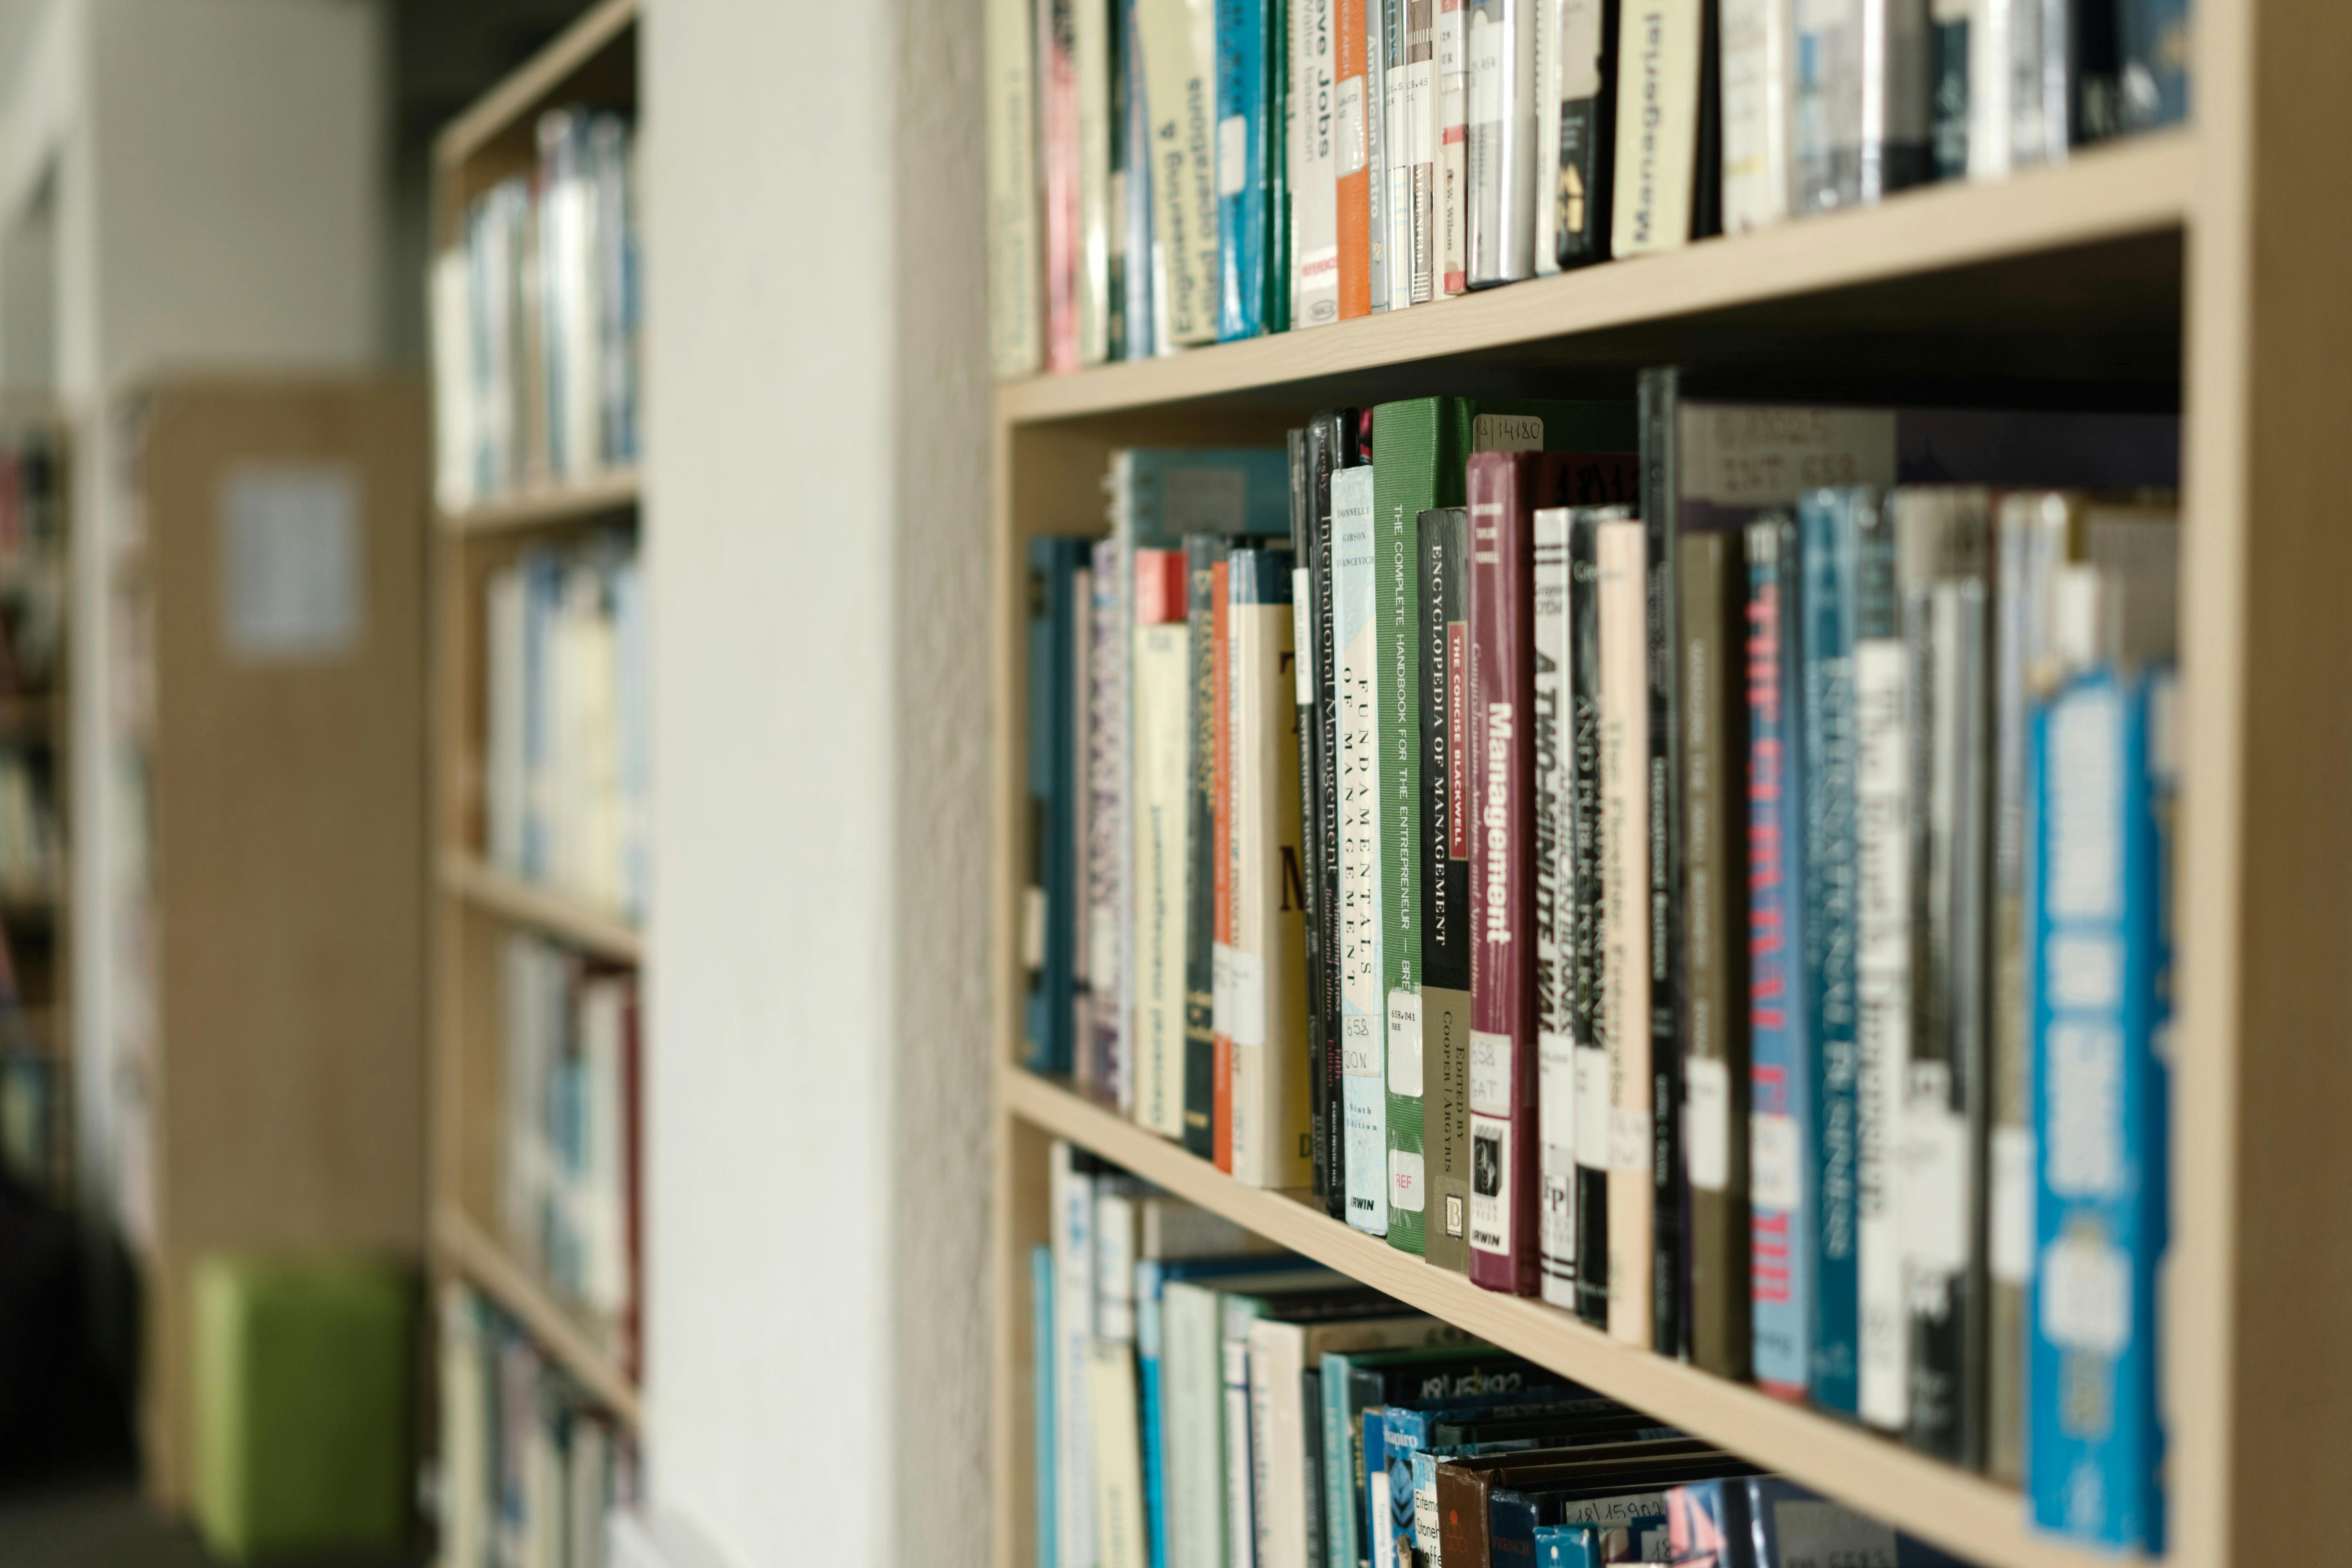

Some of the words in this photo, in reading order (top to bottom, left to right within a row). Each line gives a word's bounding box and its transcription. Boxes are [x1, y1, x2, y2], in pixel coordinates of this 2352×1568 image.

[1367, 35, 1378, 146] American
[1304, 67, 1315, 162] Isaacson
[1318, 69, 1330, 158] Jobs
[1369, 159, 1380, 218] Retro
[1337, 506, 1370, 518] DONNELLY
[1394, 504, 1402, 535] THE
[1342, 532, 1366, 542] GIBSON
[1336, 556, 1374, 567] IVANCEVICH
[1395, 541, 1404, 626] COMPLETE
[1320, 516, 1335, 688] International
[1432, 544, 1444, 728] ENCYCLOPEDIA
[1396, 634, 1406, 723] HANDBOOK
[1536, 650, 1557, 674] A
[1343, 667, 1352, 707] OF
[1398, 729, 1407, 760] FOR
[1576, 695, 1593, 772] AND
[1434, 737, 1444, 768] OF
[1324, 699, 1338, 874] Management
[1399, 768, 1407, 799] THE
[1358, 678, 1372, 975] FUNDAMENTALS
[1485, 702, 1513, 945] Management
[1344, 733, 1356, 985] MANAGEMENT
[1399, 806, 1410, 930] ENTREPRENEUR
[1435, 776, 1446, 946] MANAGEMENT
[1331, 898, 1341, 966] Managing
[1334, 971, 1342, 1011] Across
[1347, 1018, 1368, 1036] 658
[1391, 1010, 1415, 1021] 658.041
[1391, 1022, 1401, 1031] BRE
[1443, 1011, 1453, 1082] COOPER
[1471, 1041, 1496, 1067] 658
[1334, 1050, 1343, 1079] Fifth
[1456, 1046, 1466, 1113] EDITED
[1346, 1118, 1377, 1131] Edition
[1349, 1104, 1372, 1115] Ninth
[1444, 1098, 1453, 1173] ARGYRIS
[1456, 1119, 1464, 1142] BY
[1395, 1173, 1412, 1190] REF
[1350, 1196, 1374, 1211] IRWIN
[1471, 1229, 1500, 1247] IRWIN
[1384, 1429, 1418, 1449] hapiro
[1492, 1536, 1531, 1556] FRENCH
